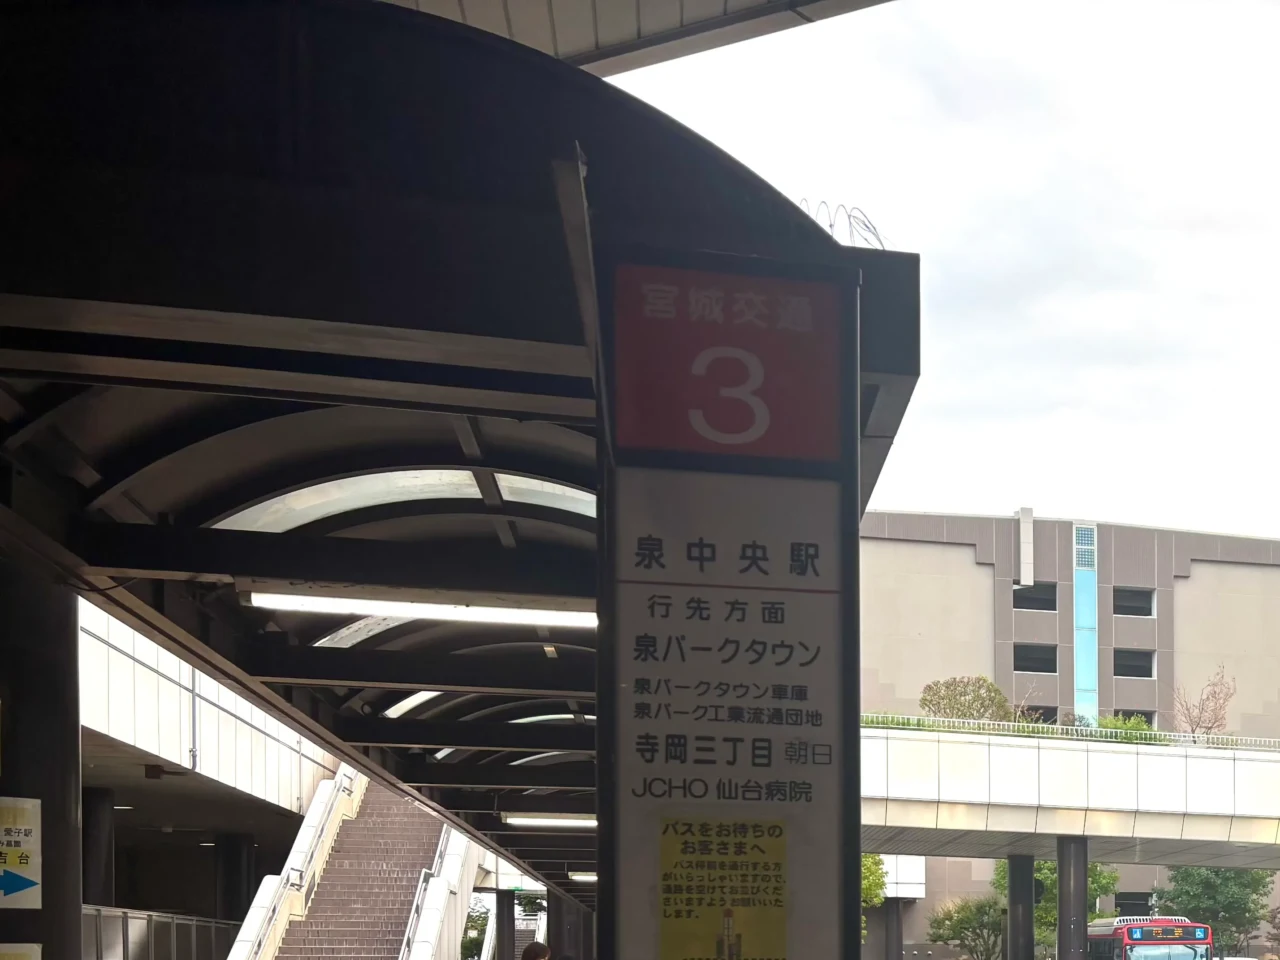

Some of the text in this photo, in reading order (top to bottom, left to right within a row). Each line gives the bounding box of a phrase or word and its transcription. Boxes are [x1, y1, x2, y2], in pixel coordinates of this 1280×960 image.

[641, 283, 814, 332] 宮城交通
[687, 346, 771, 445] 3
[634, 534, 820, 577] 泉中央駅
[647, 594, 786, 624] 行先方面
[633, 633, 821, 667] 泉パークタウン
[633, 678, 809, 702] 泉パークタウン車庫
[633, 702, 823, 727] 泉パーク工業流通団地
[635, 732, 832, 767] 寺岡三丁目 朝日
[632, 777, 813, 802] JCHO 仙台病院
[661, 821, 784, 839] バスをお待ちの
[680, 840, 766, 856] お客さまへ
